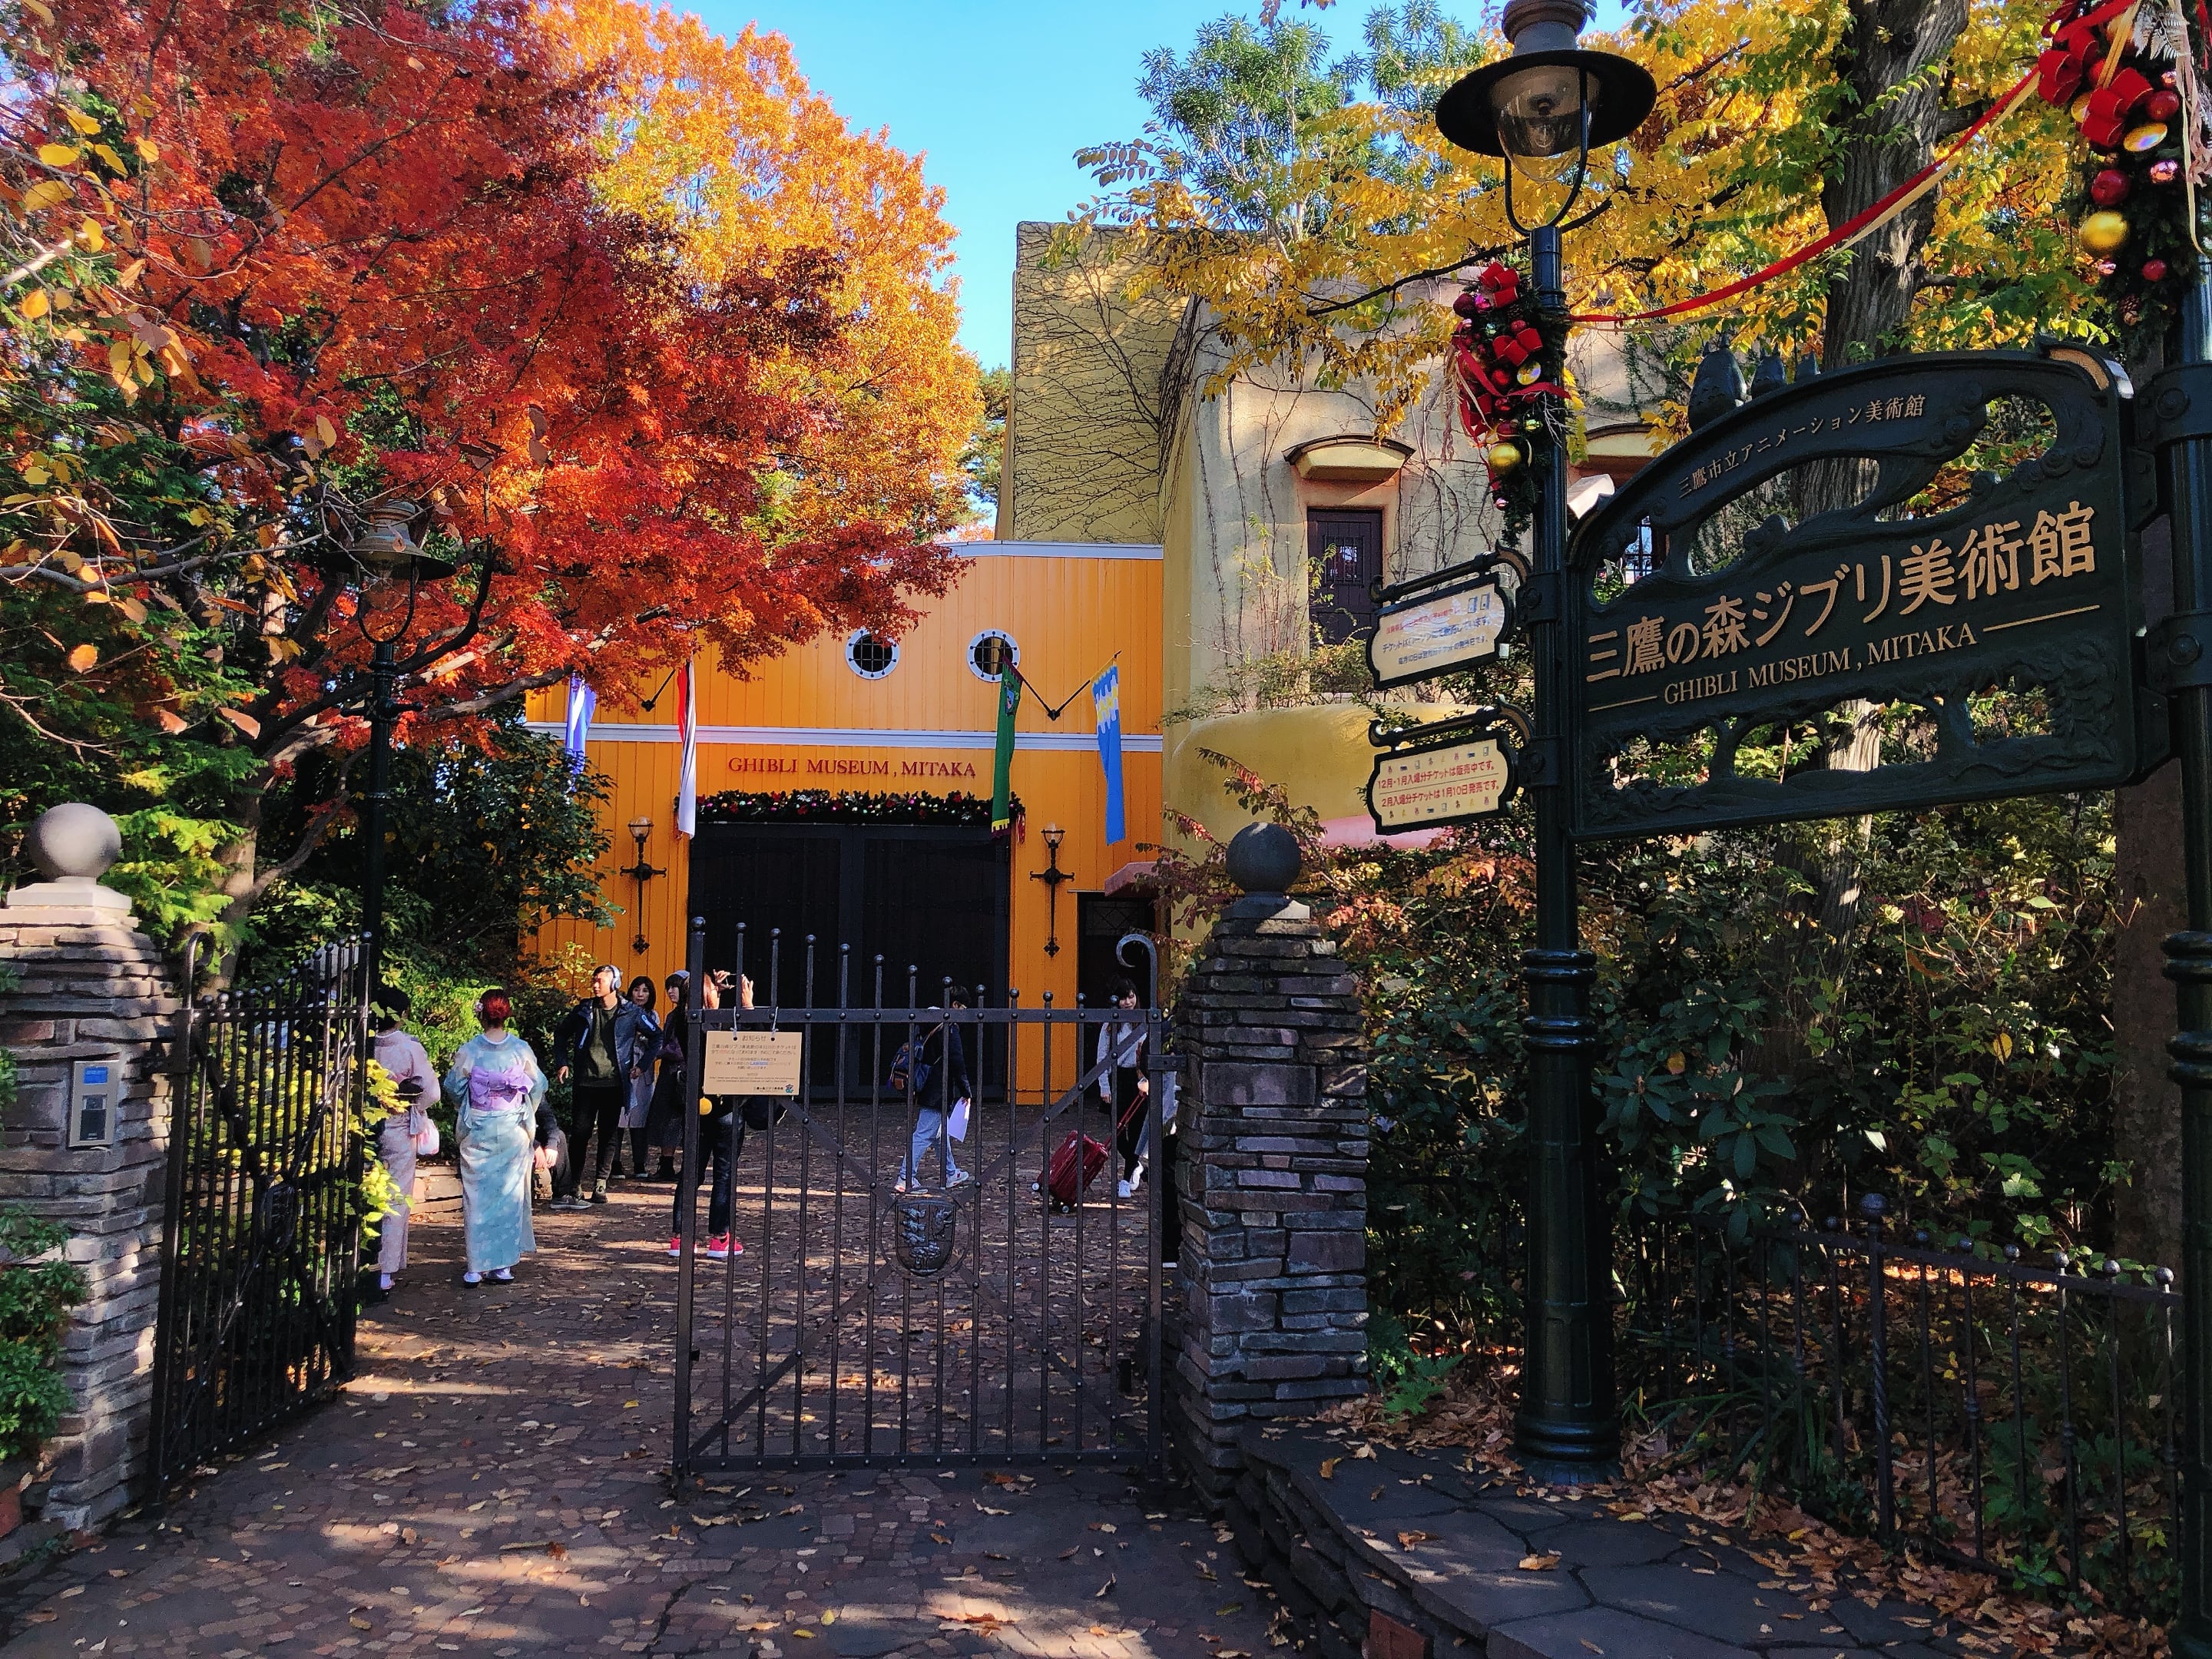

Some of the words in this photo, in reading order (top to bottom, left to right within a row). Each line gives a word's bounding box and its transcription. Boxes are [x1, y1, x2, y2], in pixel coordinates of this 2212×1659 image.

[1678, 394, 1926, 498] 三鷹市立アニメーション美術館
[1586, 501, 2097, 684] 三鷹の森ジブリ美術館
[1664, 673, 1737, 706] GHIBLI
[1868, 622, 1978, 665] MITAKA
[728, 757, 797, 773] GHIBLI
[902, 761, 976, 779] MITAKA
